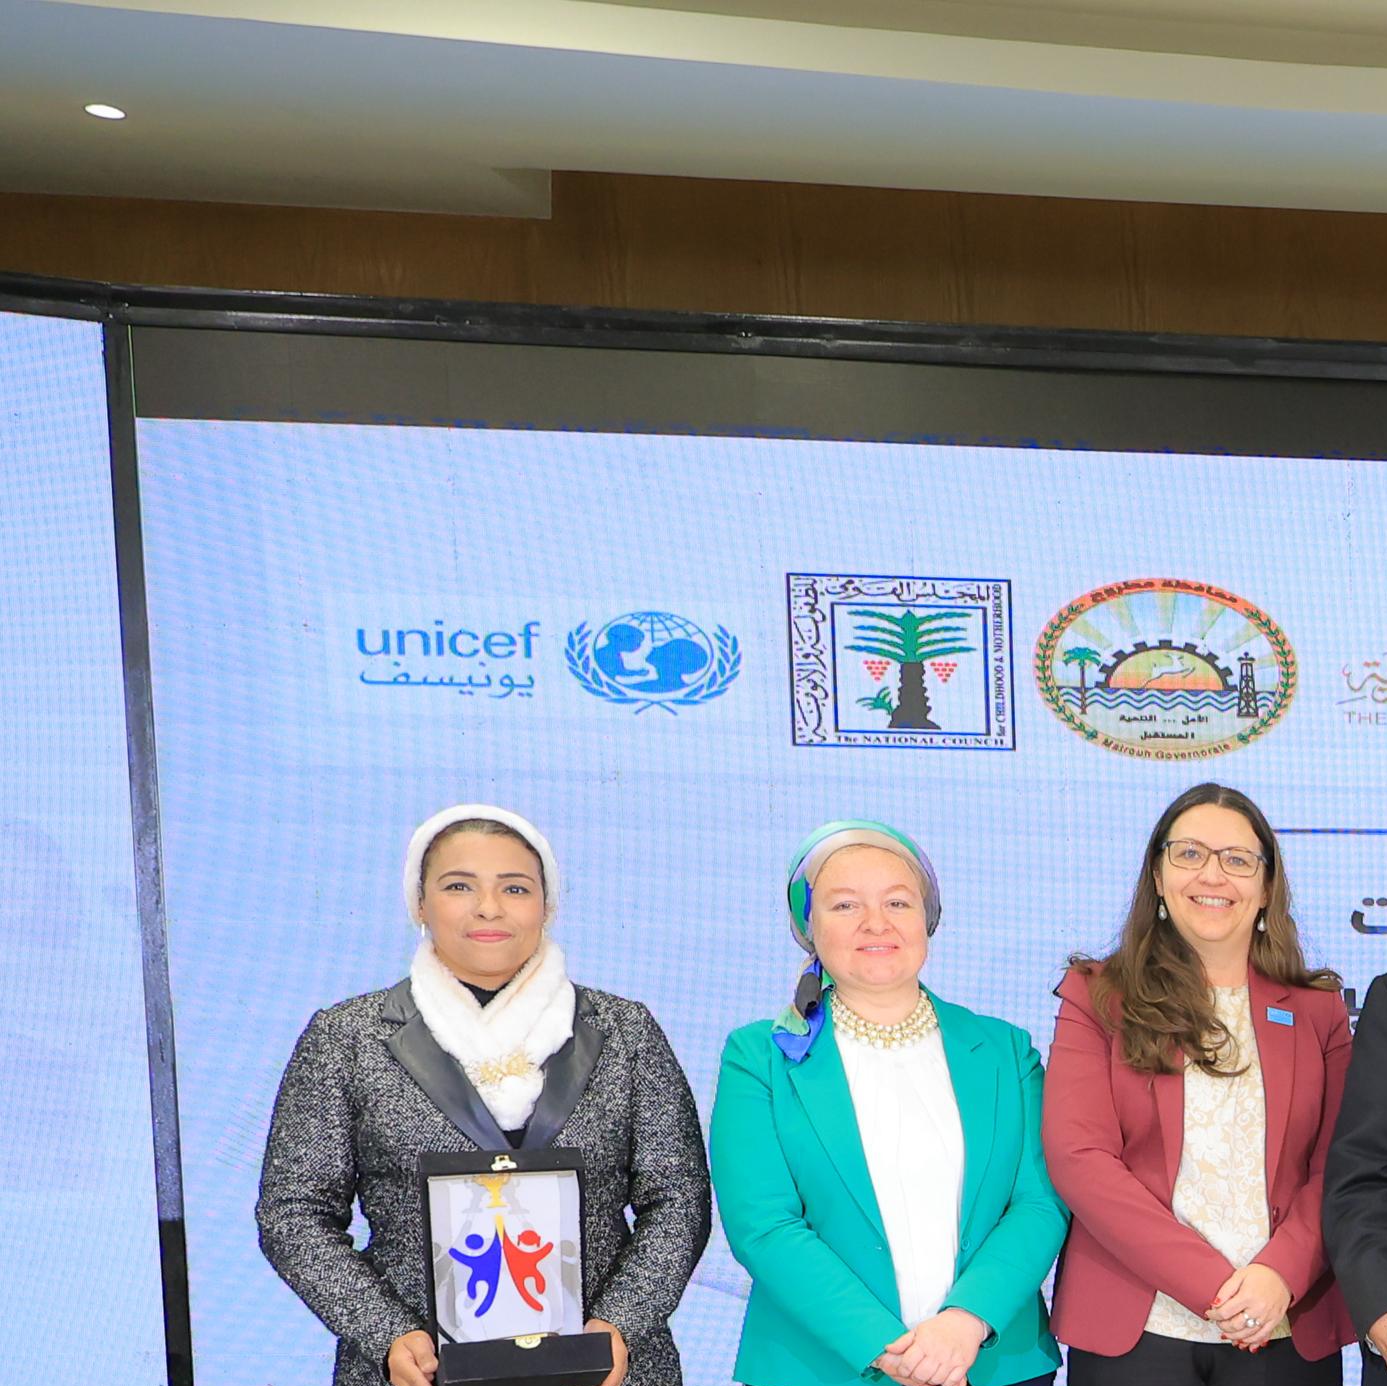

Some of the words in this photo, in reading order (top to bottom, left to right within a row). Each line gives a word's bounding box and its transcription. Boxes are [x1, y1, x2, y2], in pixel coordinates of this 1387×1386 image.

[357, 620, 541, 659] unicef
[360, 661, 535, 698] يونيسف
[836, 735, 858, 743] The
[863, 735, 937, 745] NATIONAL
[942, 737, 1006, 746] COUNCIL
[1155, 742, 1232, 760] Governorate
